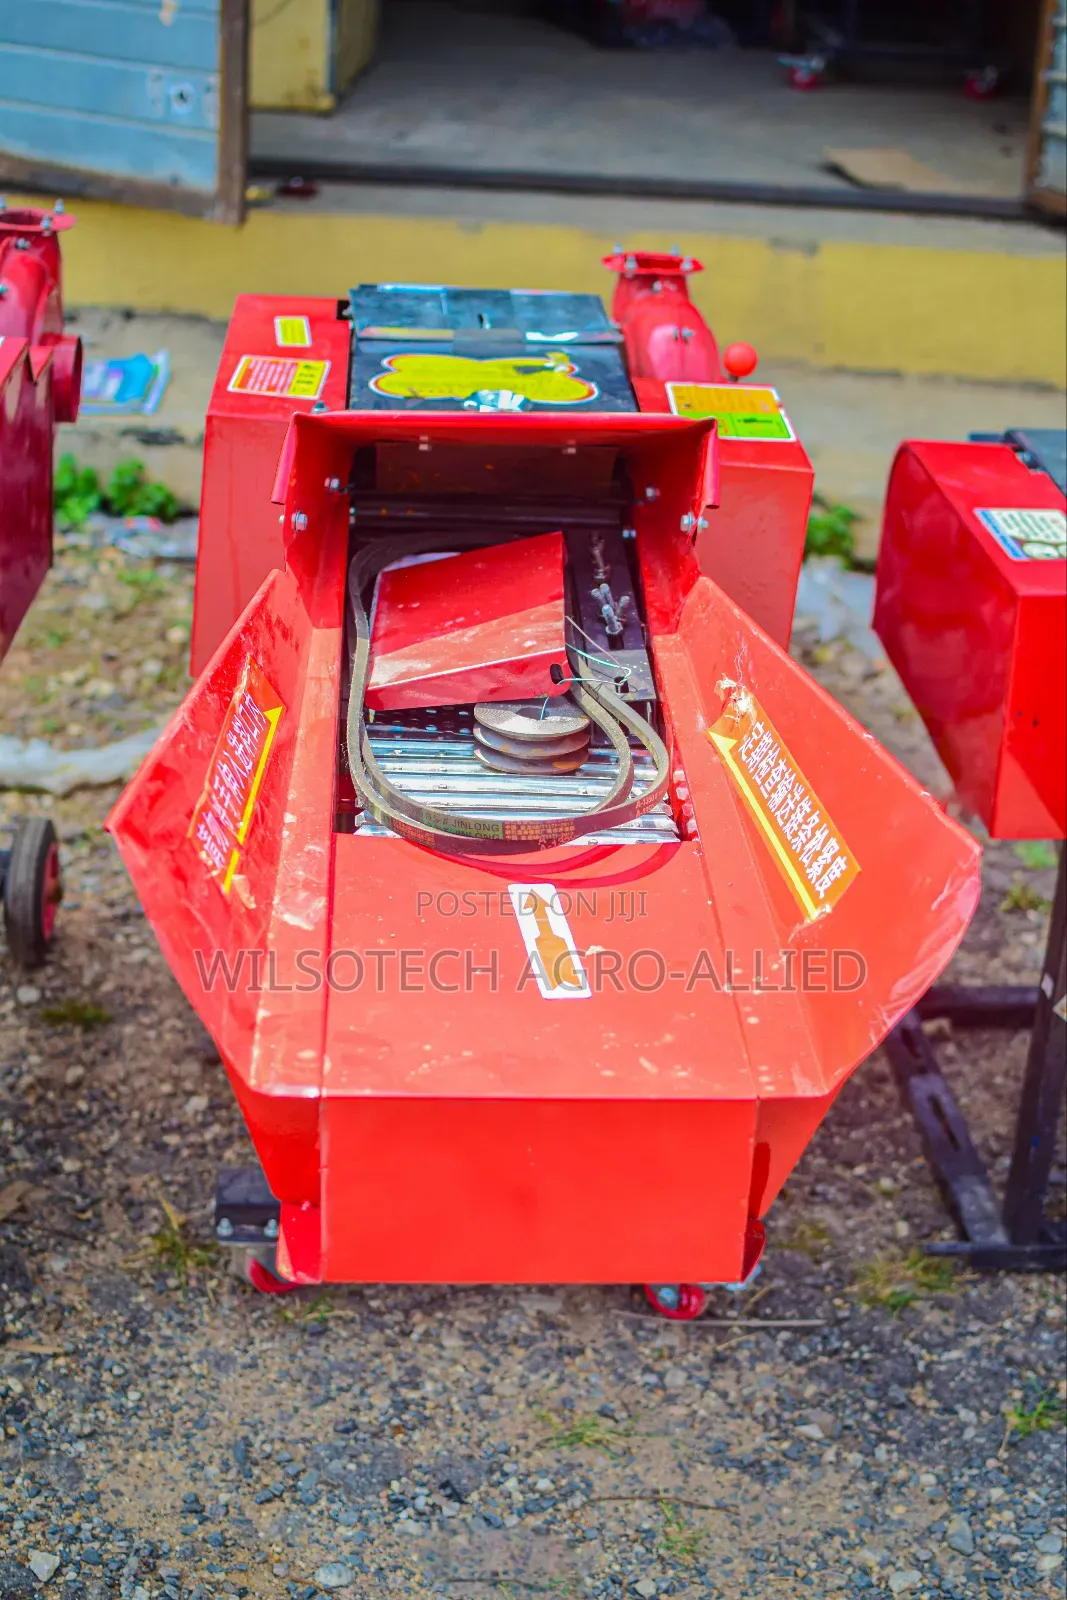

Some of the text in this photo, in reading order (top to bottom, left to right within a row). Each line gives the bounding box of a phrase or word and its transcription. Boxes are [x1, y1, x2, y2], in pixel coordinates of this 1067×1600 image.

[452, 819, 500, 832] JINLONG
[738, 721, 847, 899] 定期检查输送链条松紧度
